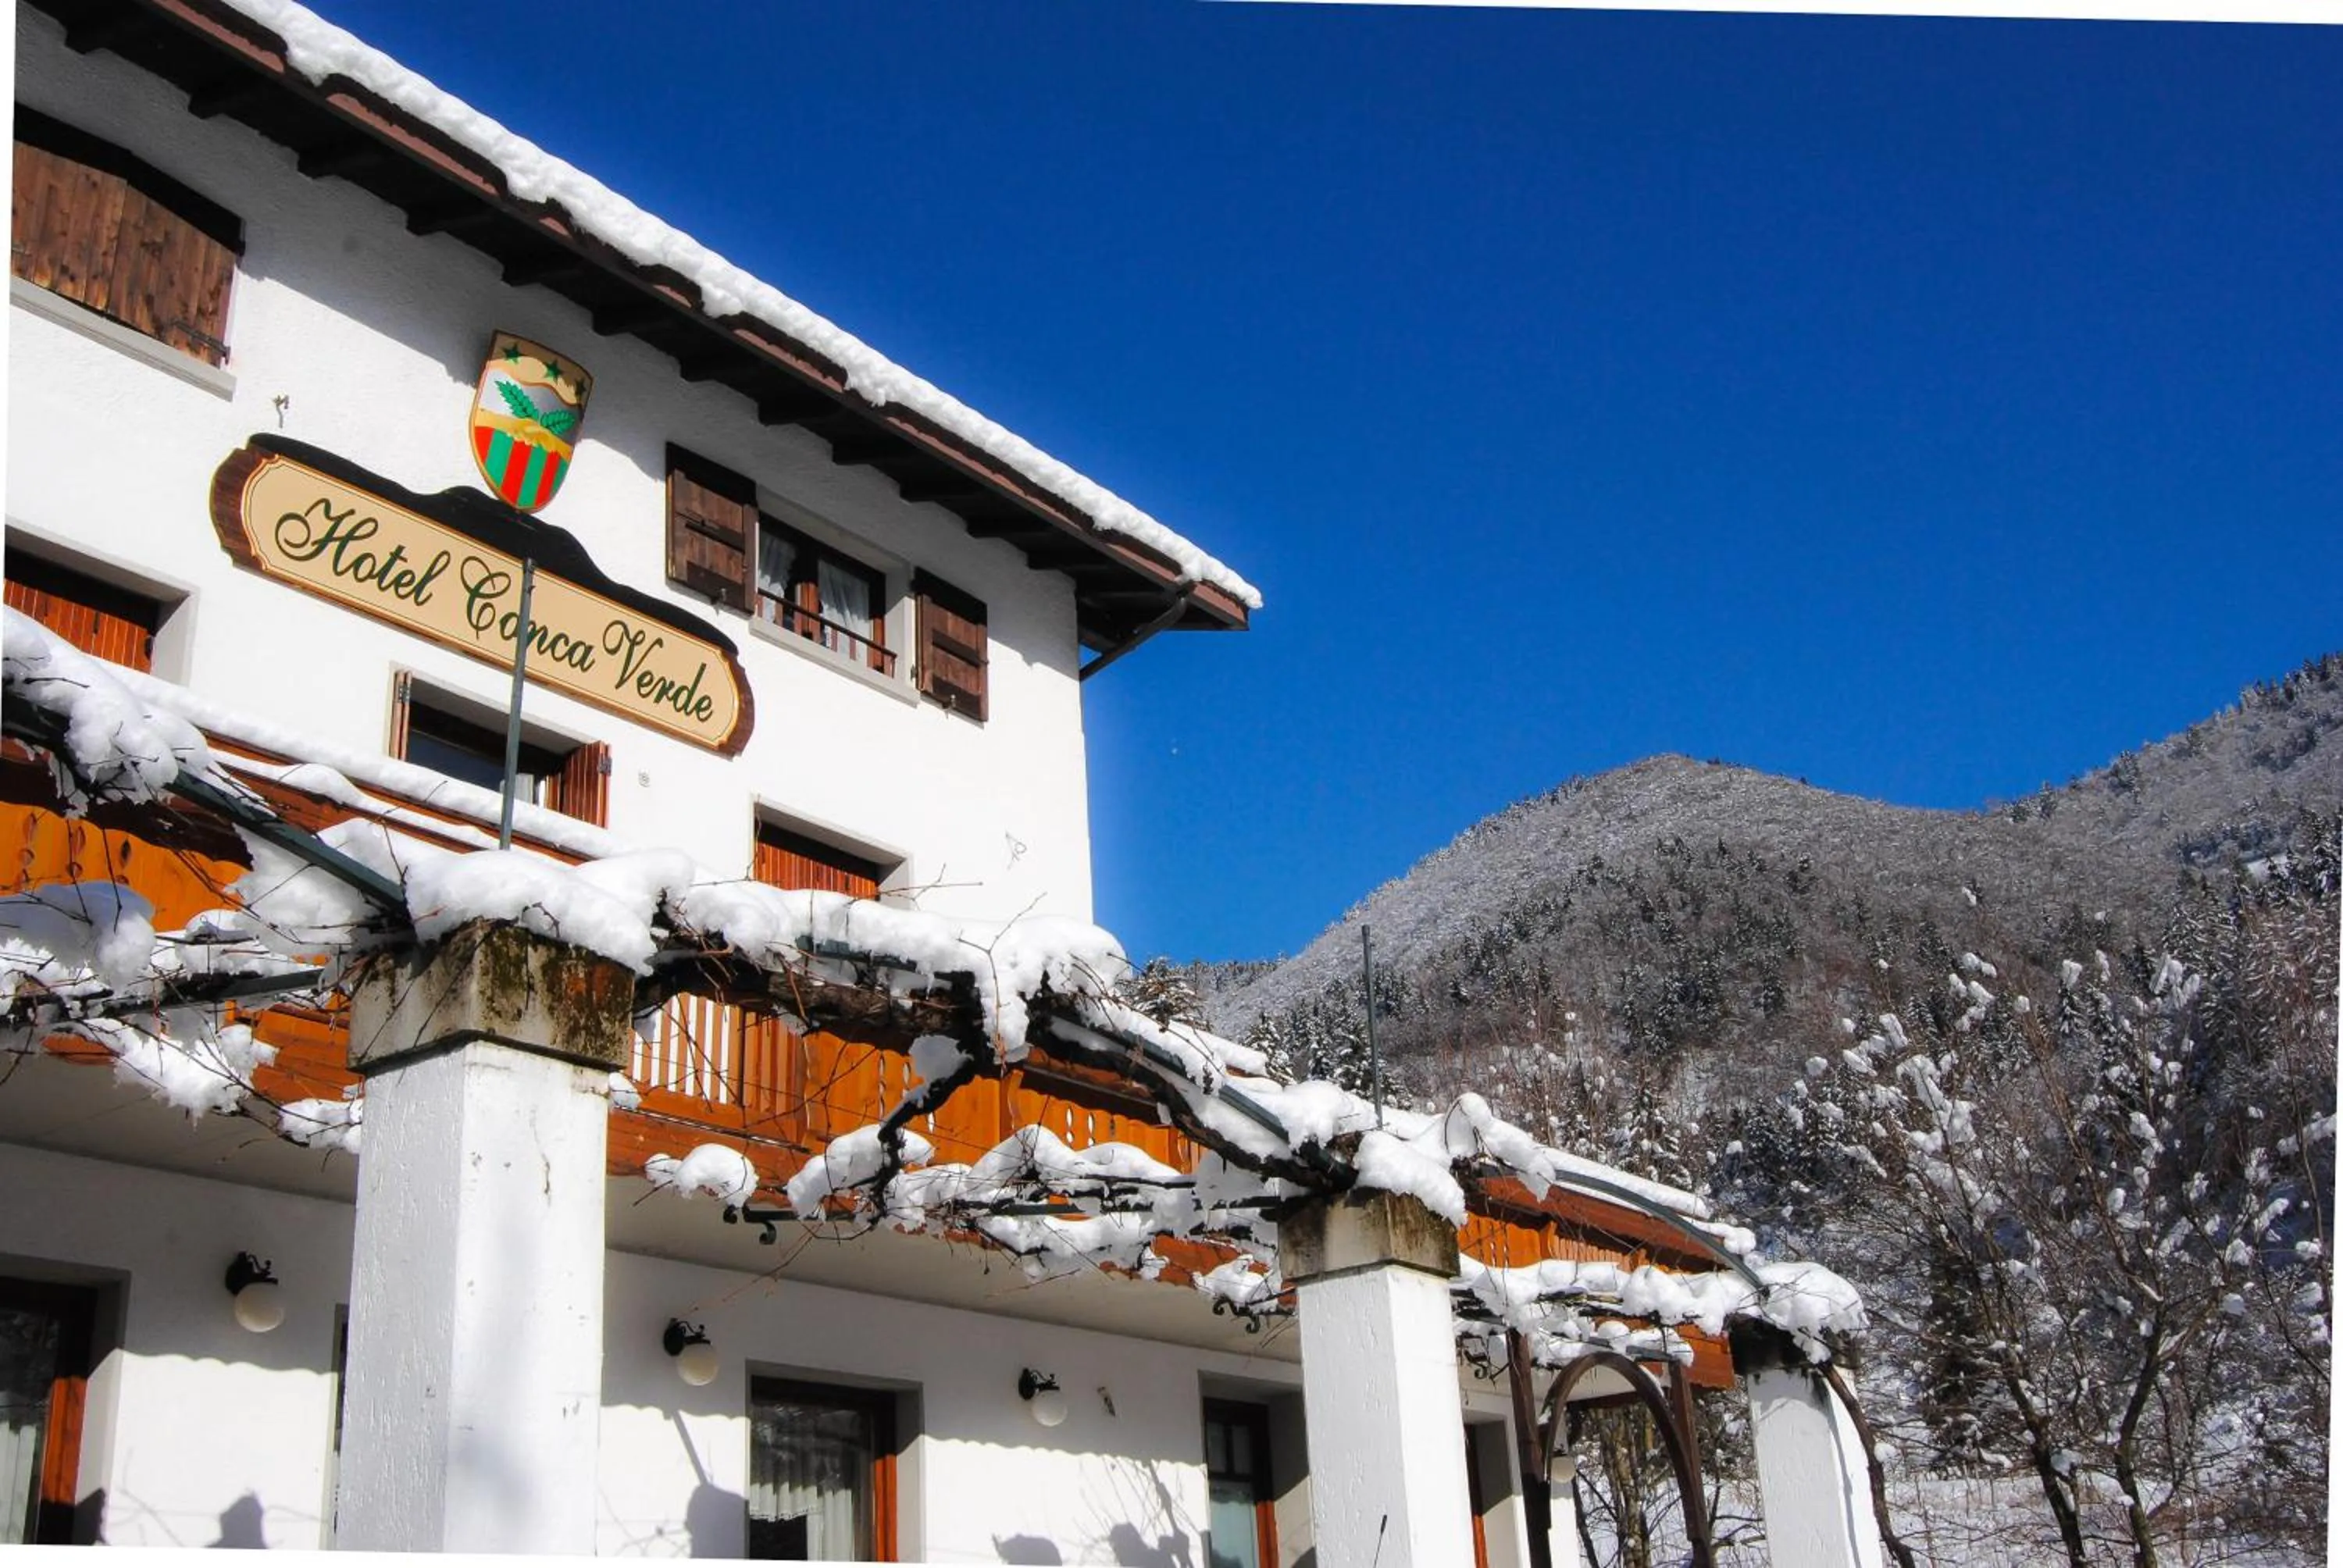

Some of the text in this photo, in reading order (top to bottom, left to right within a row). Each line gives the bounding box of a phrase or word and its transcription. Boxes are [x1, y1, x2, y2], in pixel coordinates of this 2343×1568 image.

[275, 498, 713, 722] Hotel Conca Verde
